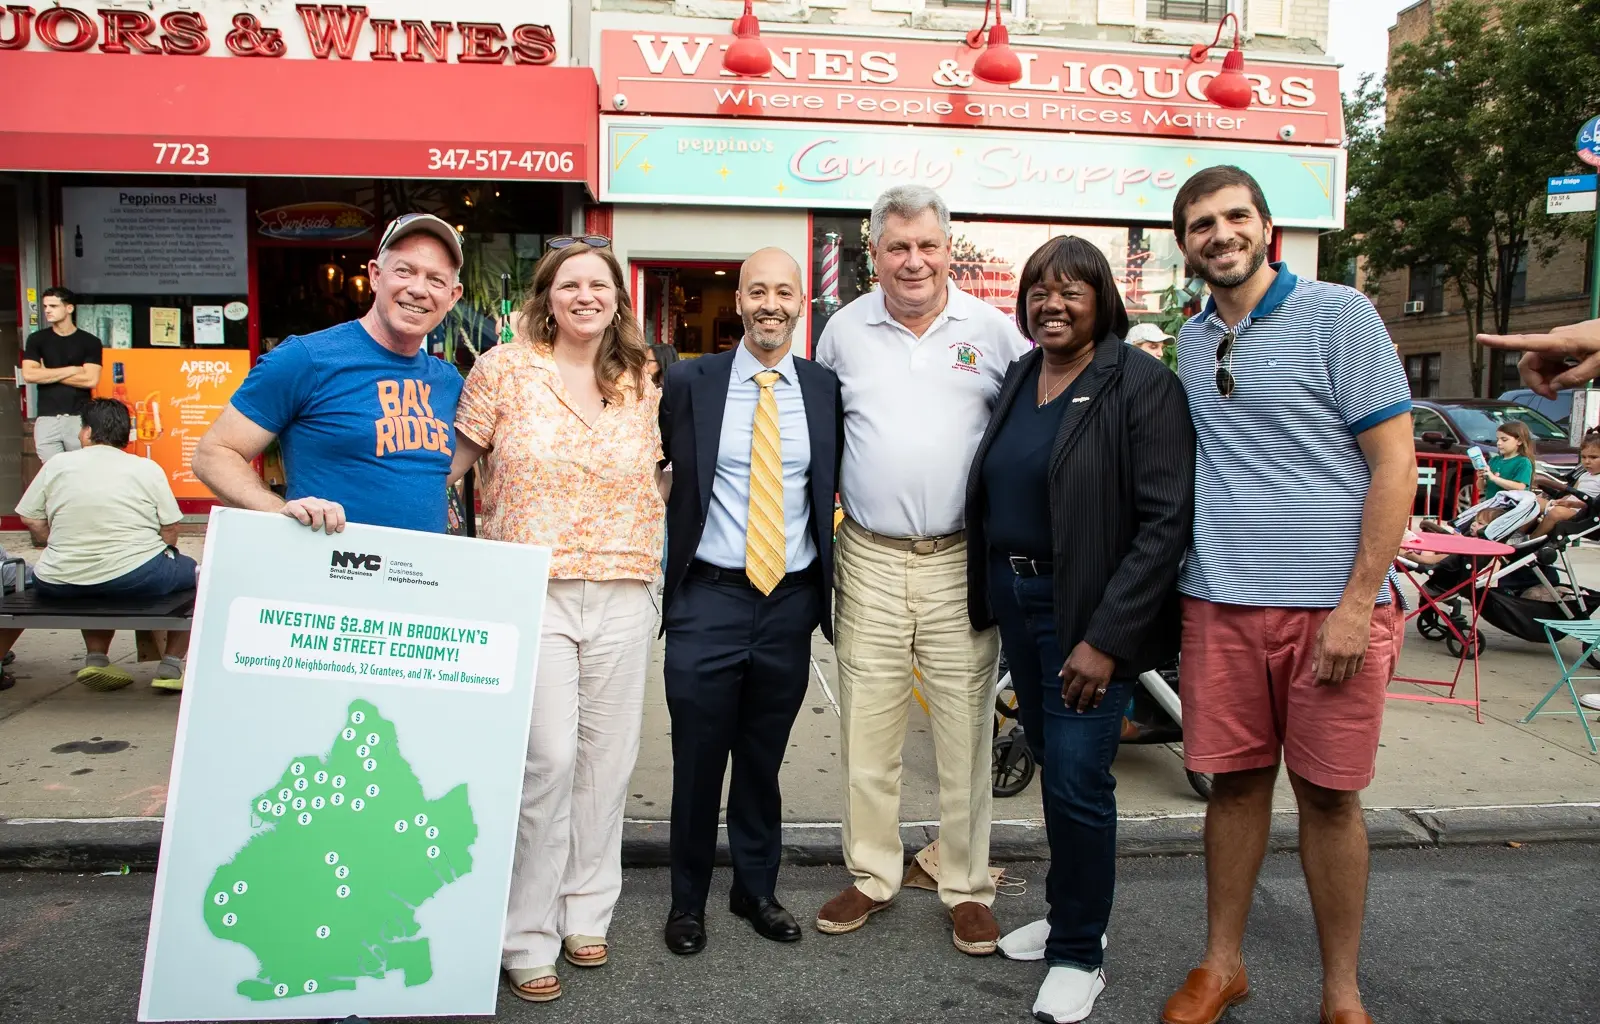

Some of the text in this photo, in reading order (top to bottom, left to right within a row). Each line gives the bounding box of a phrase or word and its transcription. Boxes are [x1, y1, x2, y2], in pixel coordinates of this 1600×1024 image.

[225, 13, 287, 57] &
[296, 4, 557, 65] WINES
[632, 34, 899, 84] WNES
[932, 59, 975, 88] &
[714, 87, 1247, 130] Where People and Prices Matter
[153, 142, 210, 166] 7723
[677, 136, 775, 155] peppino's
[428, 148, 574, 173] 347-517-4706
[788, 137, 1177, 195] Candy Shoppe
[119, 192, 217, 206] Peppinos Picks!
[268, 210, 333, 235] Surfside
[180, 360, 232, 374] APEROL
[377, 379, 434, 418] BAY
[375, 415, 452, 457] RIDGE
[331, 550, 381, 571] NYC
[389, 568, 423, 577] businesses
[387, 575, 439, 587] neighborhoods
[259, 608, 488, 645] INVESTING $2.8M IN BROOKLYN'S
[290, 633, 460, 662] MAIN STREET ECONOMY!
[235, 652, 281, 669] Supporting
[282, 656, 293, 668] 20
[294, 657, 357, 675] Neighborhoods,
[359, 662, 369, 675] 32
[370, 663, 406, 679] Grantees,
[407, 668, 421, 679] and
[438, 670, 459, 682] Small
[461, 672, 500, 686] Businesses
